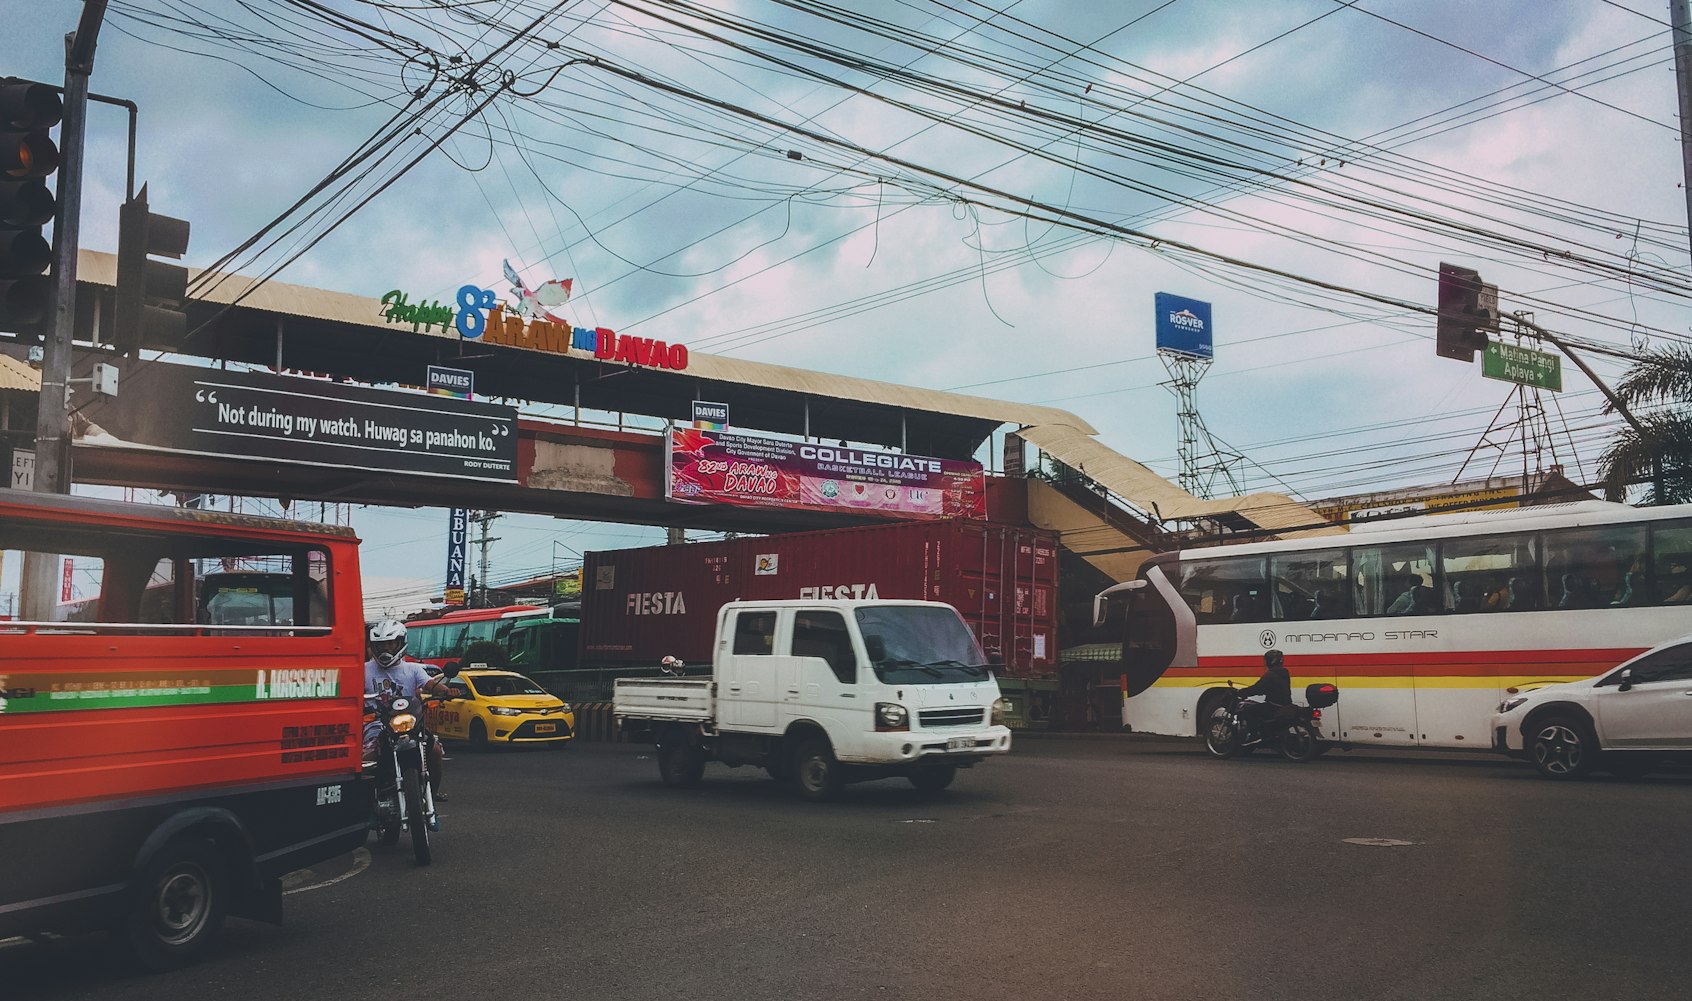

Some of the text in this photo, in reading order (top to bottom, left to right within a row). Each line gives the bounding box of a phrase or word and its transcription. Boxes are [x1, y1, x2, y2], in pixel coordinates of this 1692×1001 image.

[381, 289, 455, 333] Happy
[483, 309, 571, 353] ARAW
[595, 327, 688, 370] DAVAO
[1500, 345, 1555, 373] Matina Pangi
[430, 372, 470, 387] DAVIES
[1504, 362, 1534, 382] Aplaya
[695, 406, 726, 418] DAVIES
[218, 402, 496, 451] Not during my watch. Huwag sa panahon ko.
[736, 435, 747, 444] City
[747, 437, 763, 445] Mayor
[743, 443, 775, 453] Development
[13, 457, 35, 468] EFT
[464, 460, 511, 471] RODY DUTERTE
[800, 446, 942, 473] COLLEGIATE
[729, 461, 766, 476] ARAW
[817, 462, 885, 477] BASKETBALL
[888, 470, 928, 481] LEAGUE
[724, 474, 777, 494] DAVAO
[626, 591, 686, 615] FIESTA
[1285, 630, 1438, 643] MINDANAO STAR
